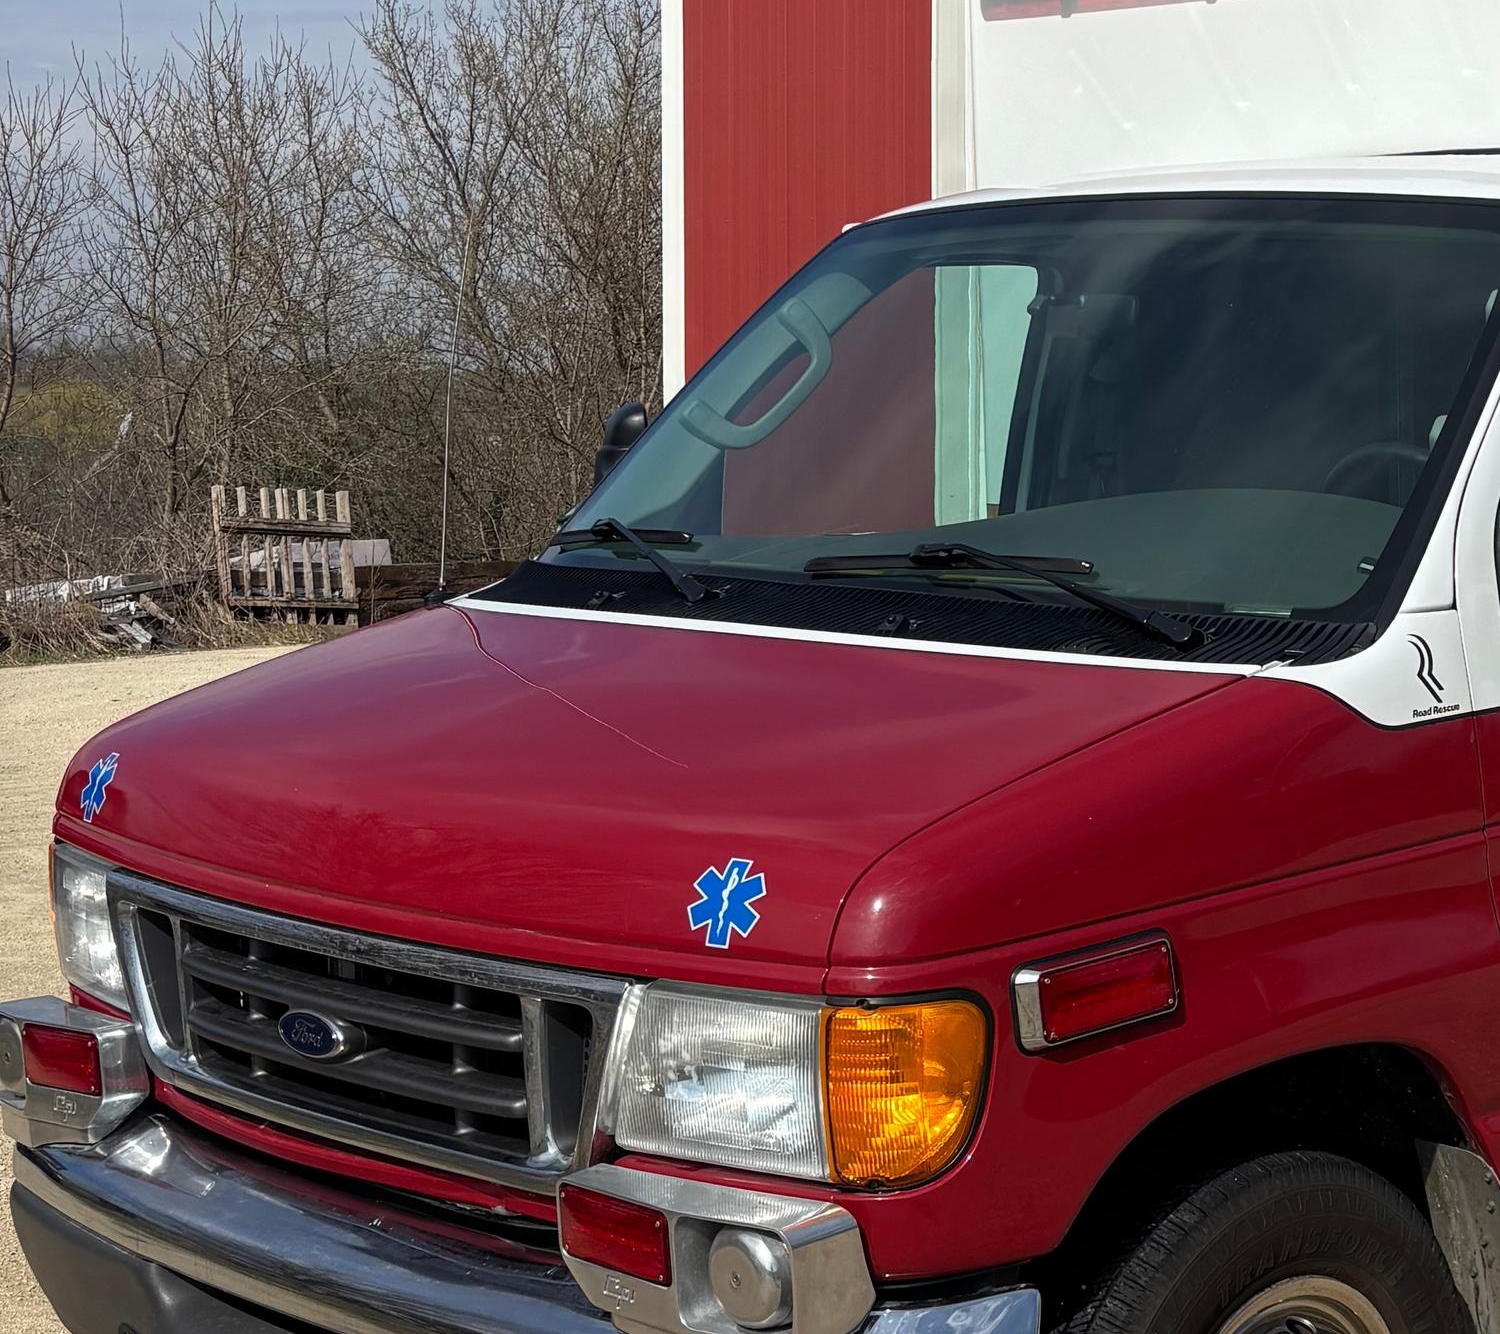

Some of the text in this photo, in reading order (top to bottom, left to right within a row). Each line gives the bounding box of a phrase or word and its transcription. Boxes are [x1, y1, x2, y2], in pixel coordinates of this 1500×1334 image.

[1412, 703, 1460, 718] Road Rescue
[291, 1018, 324, 1048] Ford
[1216, 1225, 1410, 1310] TRANSFORCE
